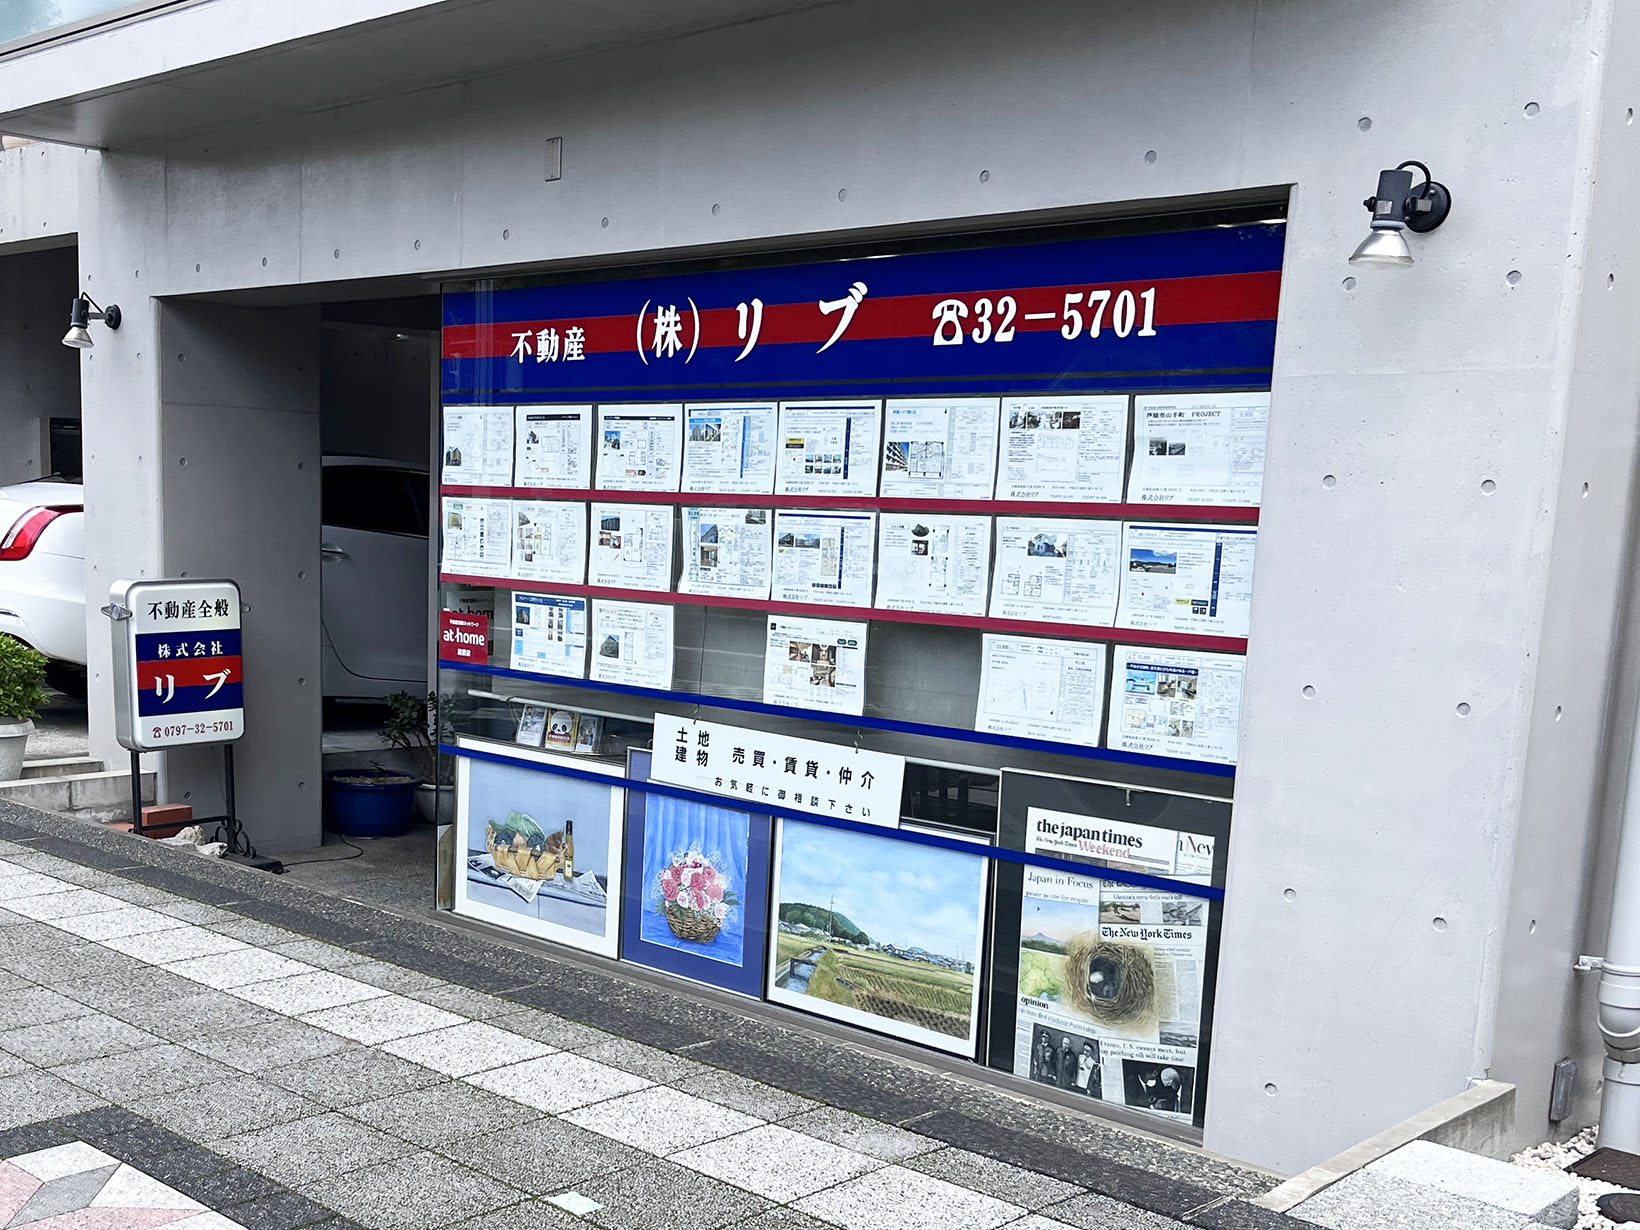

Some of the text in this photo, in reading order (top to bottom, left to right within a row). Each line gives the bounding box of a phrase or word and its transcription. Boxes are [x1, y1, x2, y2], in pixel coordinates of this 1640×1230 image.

[510, 326, 586, 364] 不動産
[636, 296, 700, 364] (株)
[972, 288, 1157, 344] 32-5701
[148, 598, 229, 621] 不動産全般
[158, 640, 223, 659] 株式会社
[154, 668, 231, 704] リブ
[164, 720, 234, 737] 0797-32-5701
[676, 726, 710, 747] 土地
[675, 746, 709, 767] 建物
[714, 776, 872, 818] お気軽に御相談下さい
[1036, 818, 1143, 848] the japan times
[1078, 840, 1131, 858] Weekend
[1028, 872, 1094, 889] Japan in Focus
[1101, 926, 1192, 940] The New York Times
[1020, 996, 1049, 1010] opinion
